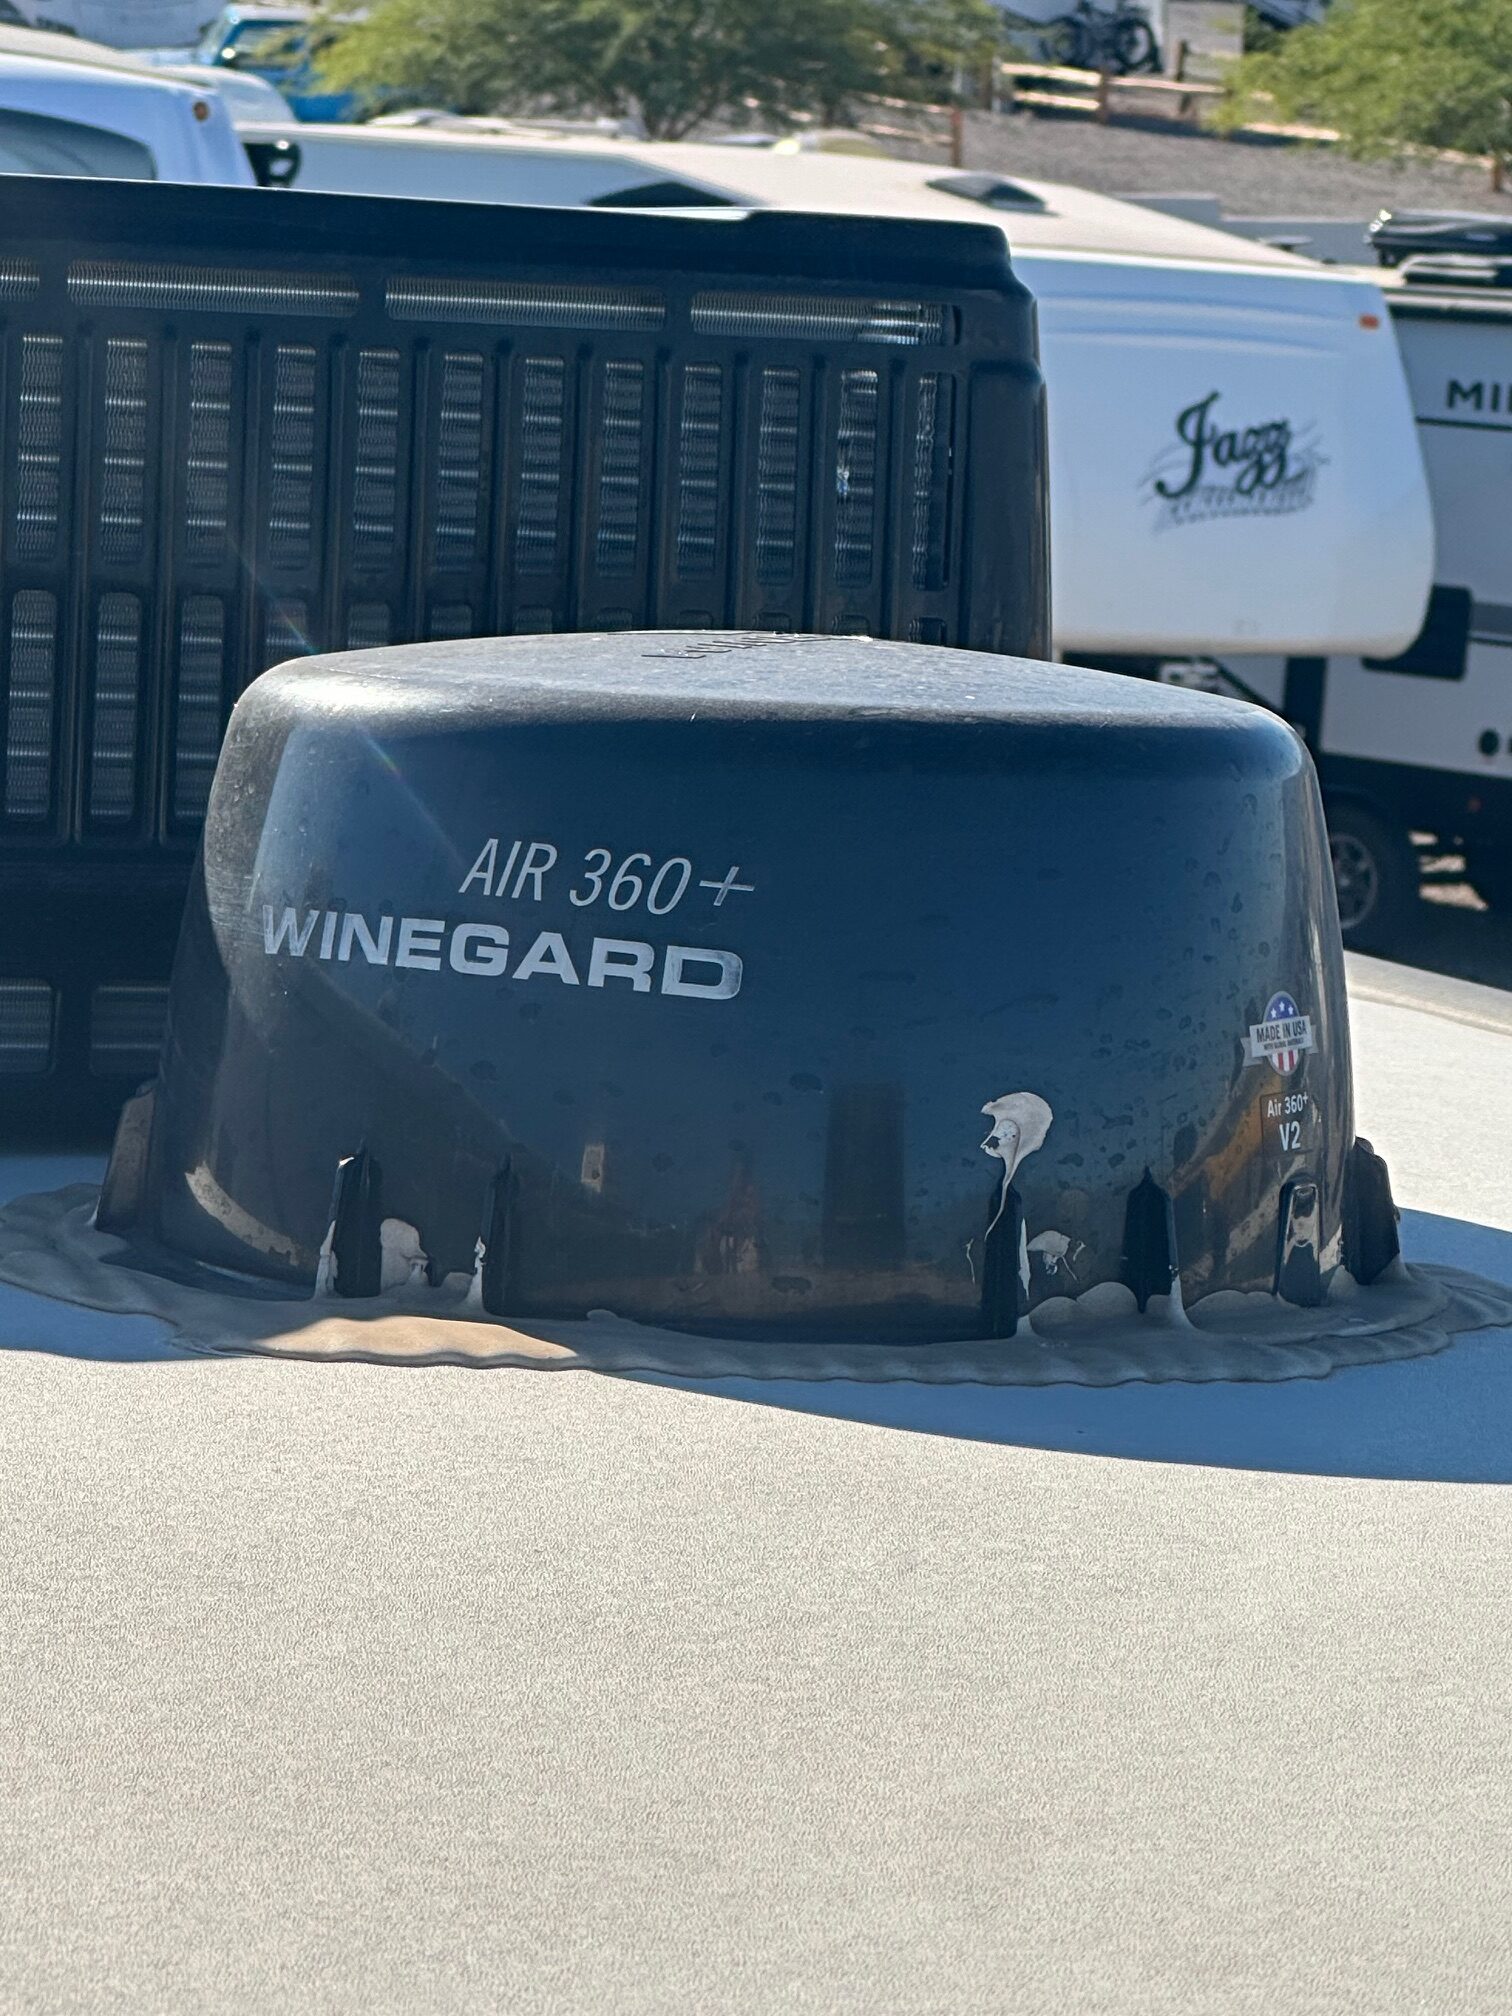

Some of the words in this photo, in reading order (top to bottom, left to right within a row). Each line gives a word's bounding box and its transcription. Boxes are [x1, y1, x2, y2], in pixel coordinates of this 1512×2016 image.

[1446, 379, 1512, 414] MI
[1155, 390, 1307, 498] Jazz
[458, 838, 557, 901] AIR
[569, 847, 755, 915] 360+
[262, 904, 743, 1000] WINEGARD
[1256, 1024, 1280, 1043] MADE
[1282, 1022, 1291, 1039] IN
[1292, 1019, 1307, 1036] USA
[1267, 1100, 1281, 1118] Air
[1284, 1092, 1308, 1115] 360+
[1279, 1121, 1301, 1151] V2
